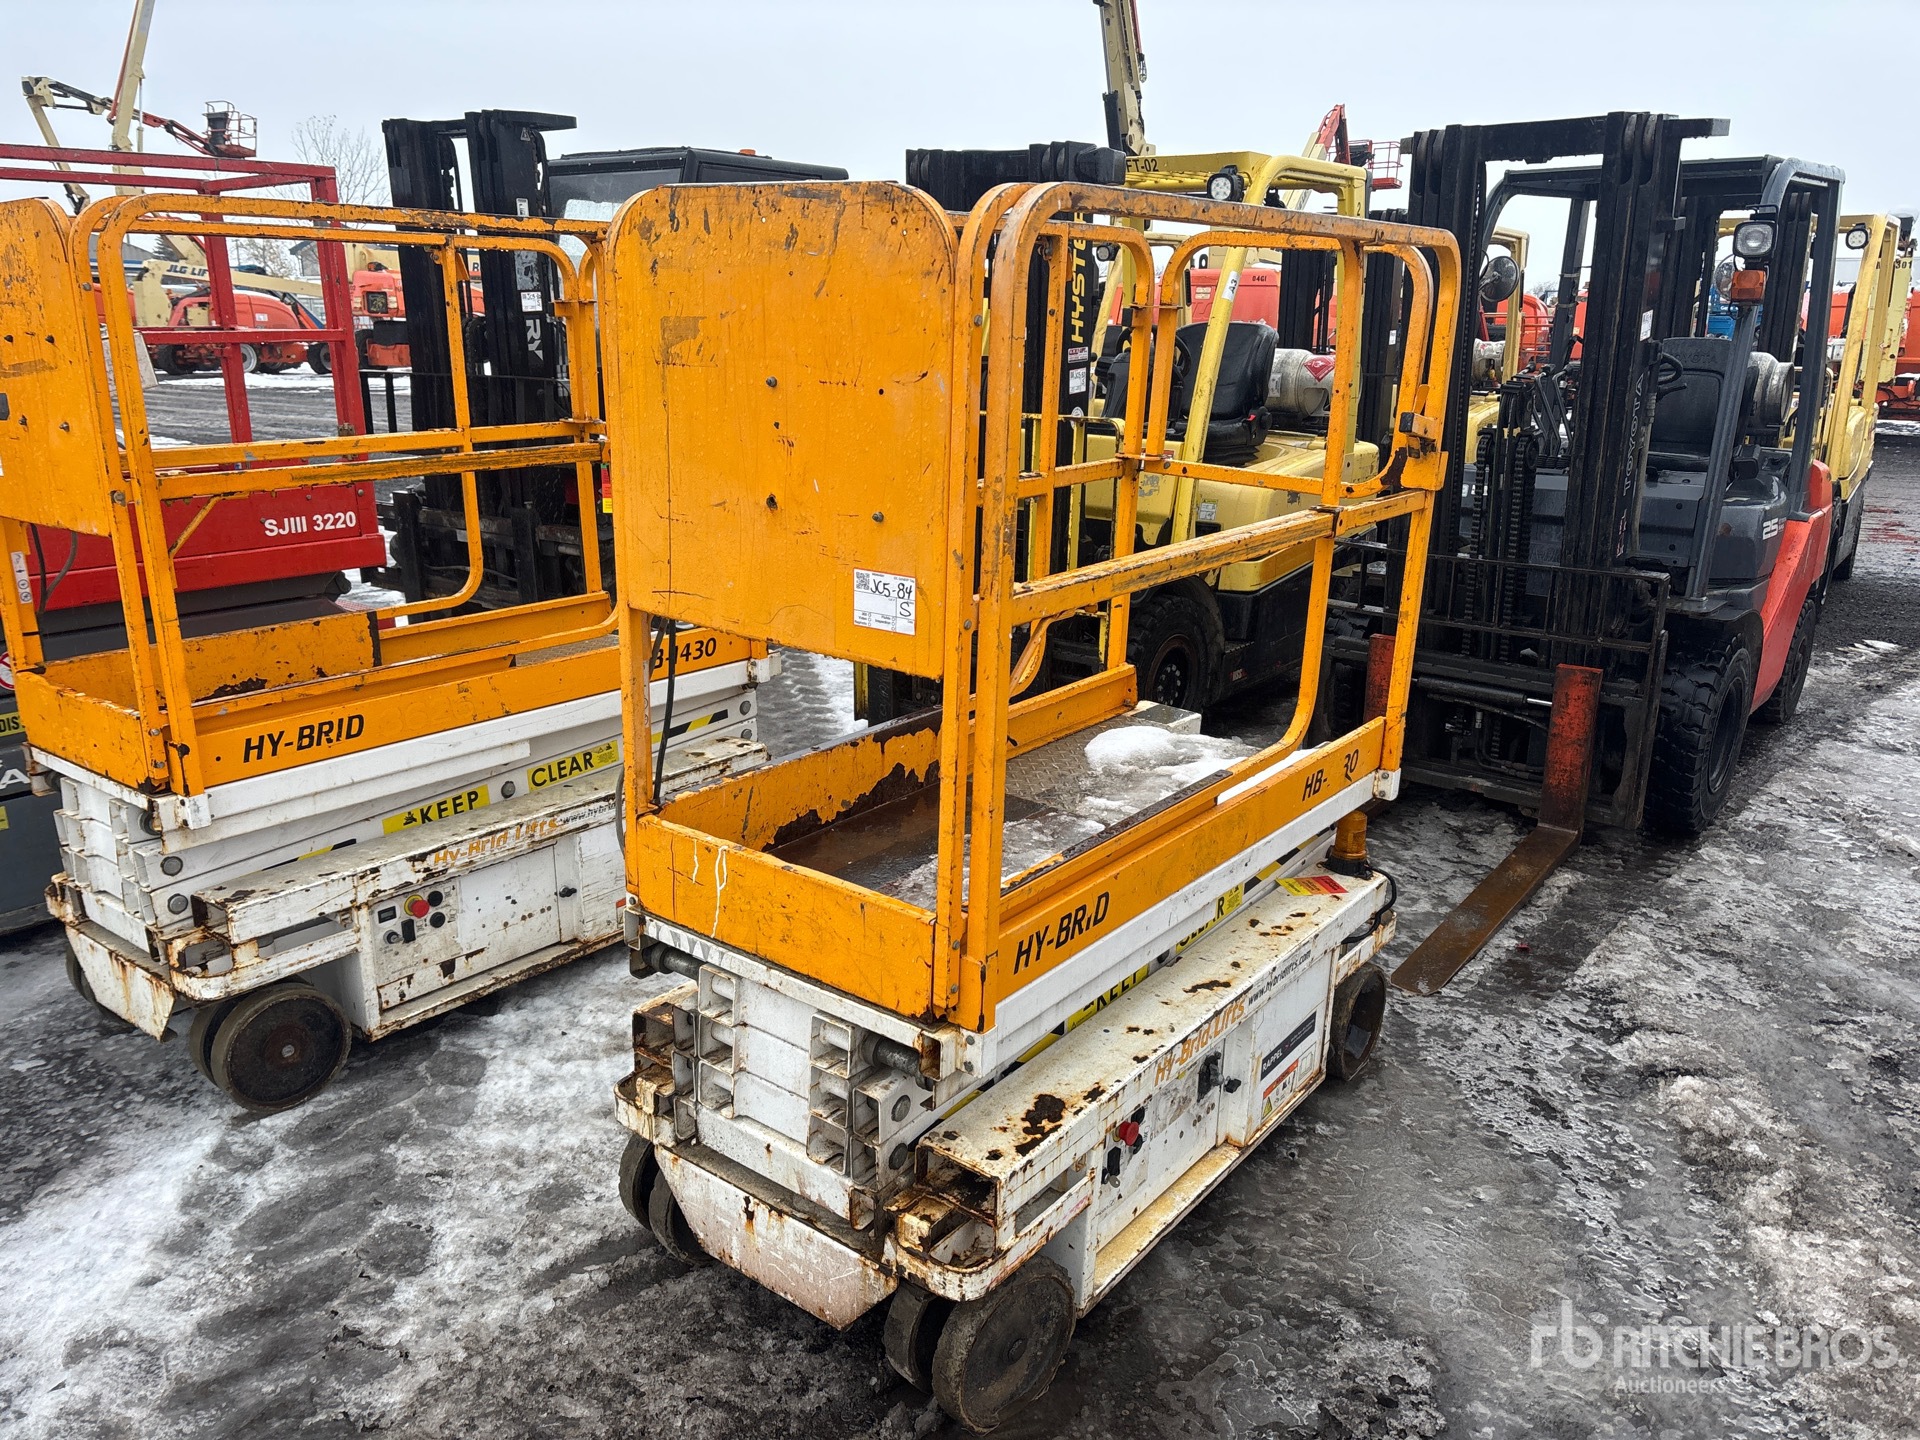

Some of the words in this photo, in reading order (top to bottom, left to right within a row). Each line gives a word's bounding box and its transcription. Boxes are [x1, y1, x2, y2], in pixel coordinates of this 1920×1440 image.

[166, 263, 187, 275] JLG
[191, 267, 209, 277] LIF
[1623, 372, 1644, 497] TOYOTA
[263, 516, 308, 537] SJIII
[312, 511, 357, 532] 3220
[1762, 517, 1779, 540] 25
[243, 713, 366, 763] HY-BRID
[420, 790, 479, 825] KEEP
[531, 751, 595, 788] CLEAR
[1013, 891, 1110, 976] HY-BRID
[1262, 1048, 1283, 1073] RAPPEL
